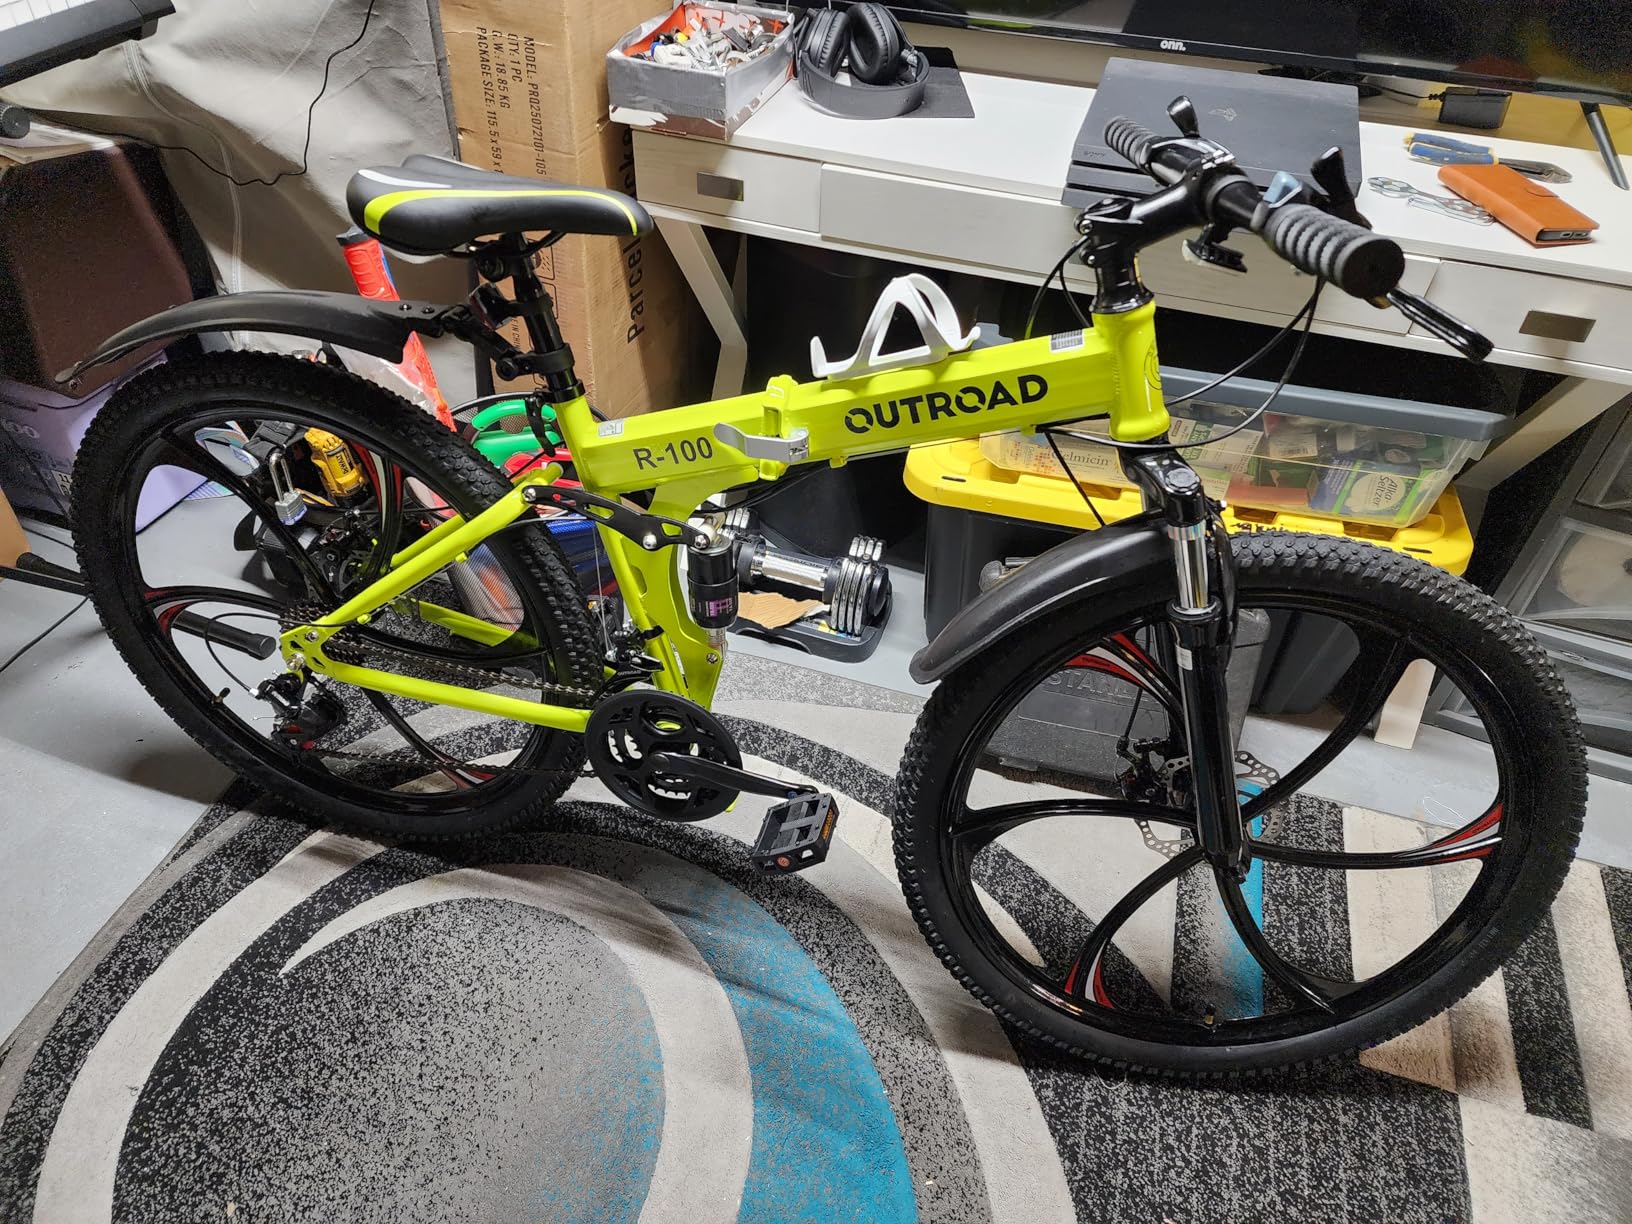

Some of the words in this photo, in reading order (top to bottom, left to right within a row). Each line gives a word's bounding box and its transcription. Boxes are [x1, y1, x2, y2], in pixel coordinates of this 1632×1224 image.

[476, 26, 492, 79] PACKAGE
[523, 36, 537, 79] MODEL:
[1160, 40, 1187, 51] onn.
[511, 67, 523, 83] PC
[482, 79, 497, 108] SIZE:
[499, 94, 511, 109] KG
[623, 237, 645, 344] Parcel
[844, 374, 1049, 434] OUTROAD
[633, 437, 713, 470] R-100
[1375, 475, 1390, 508] Seltzer
